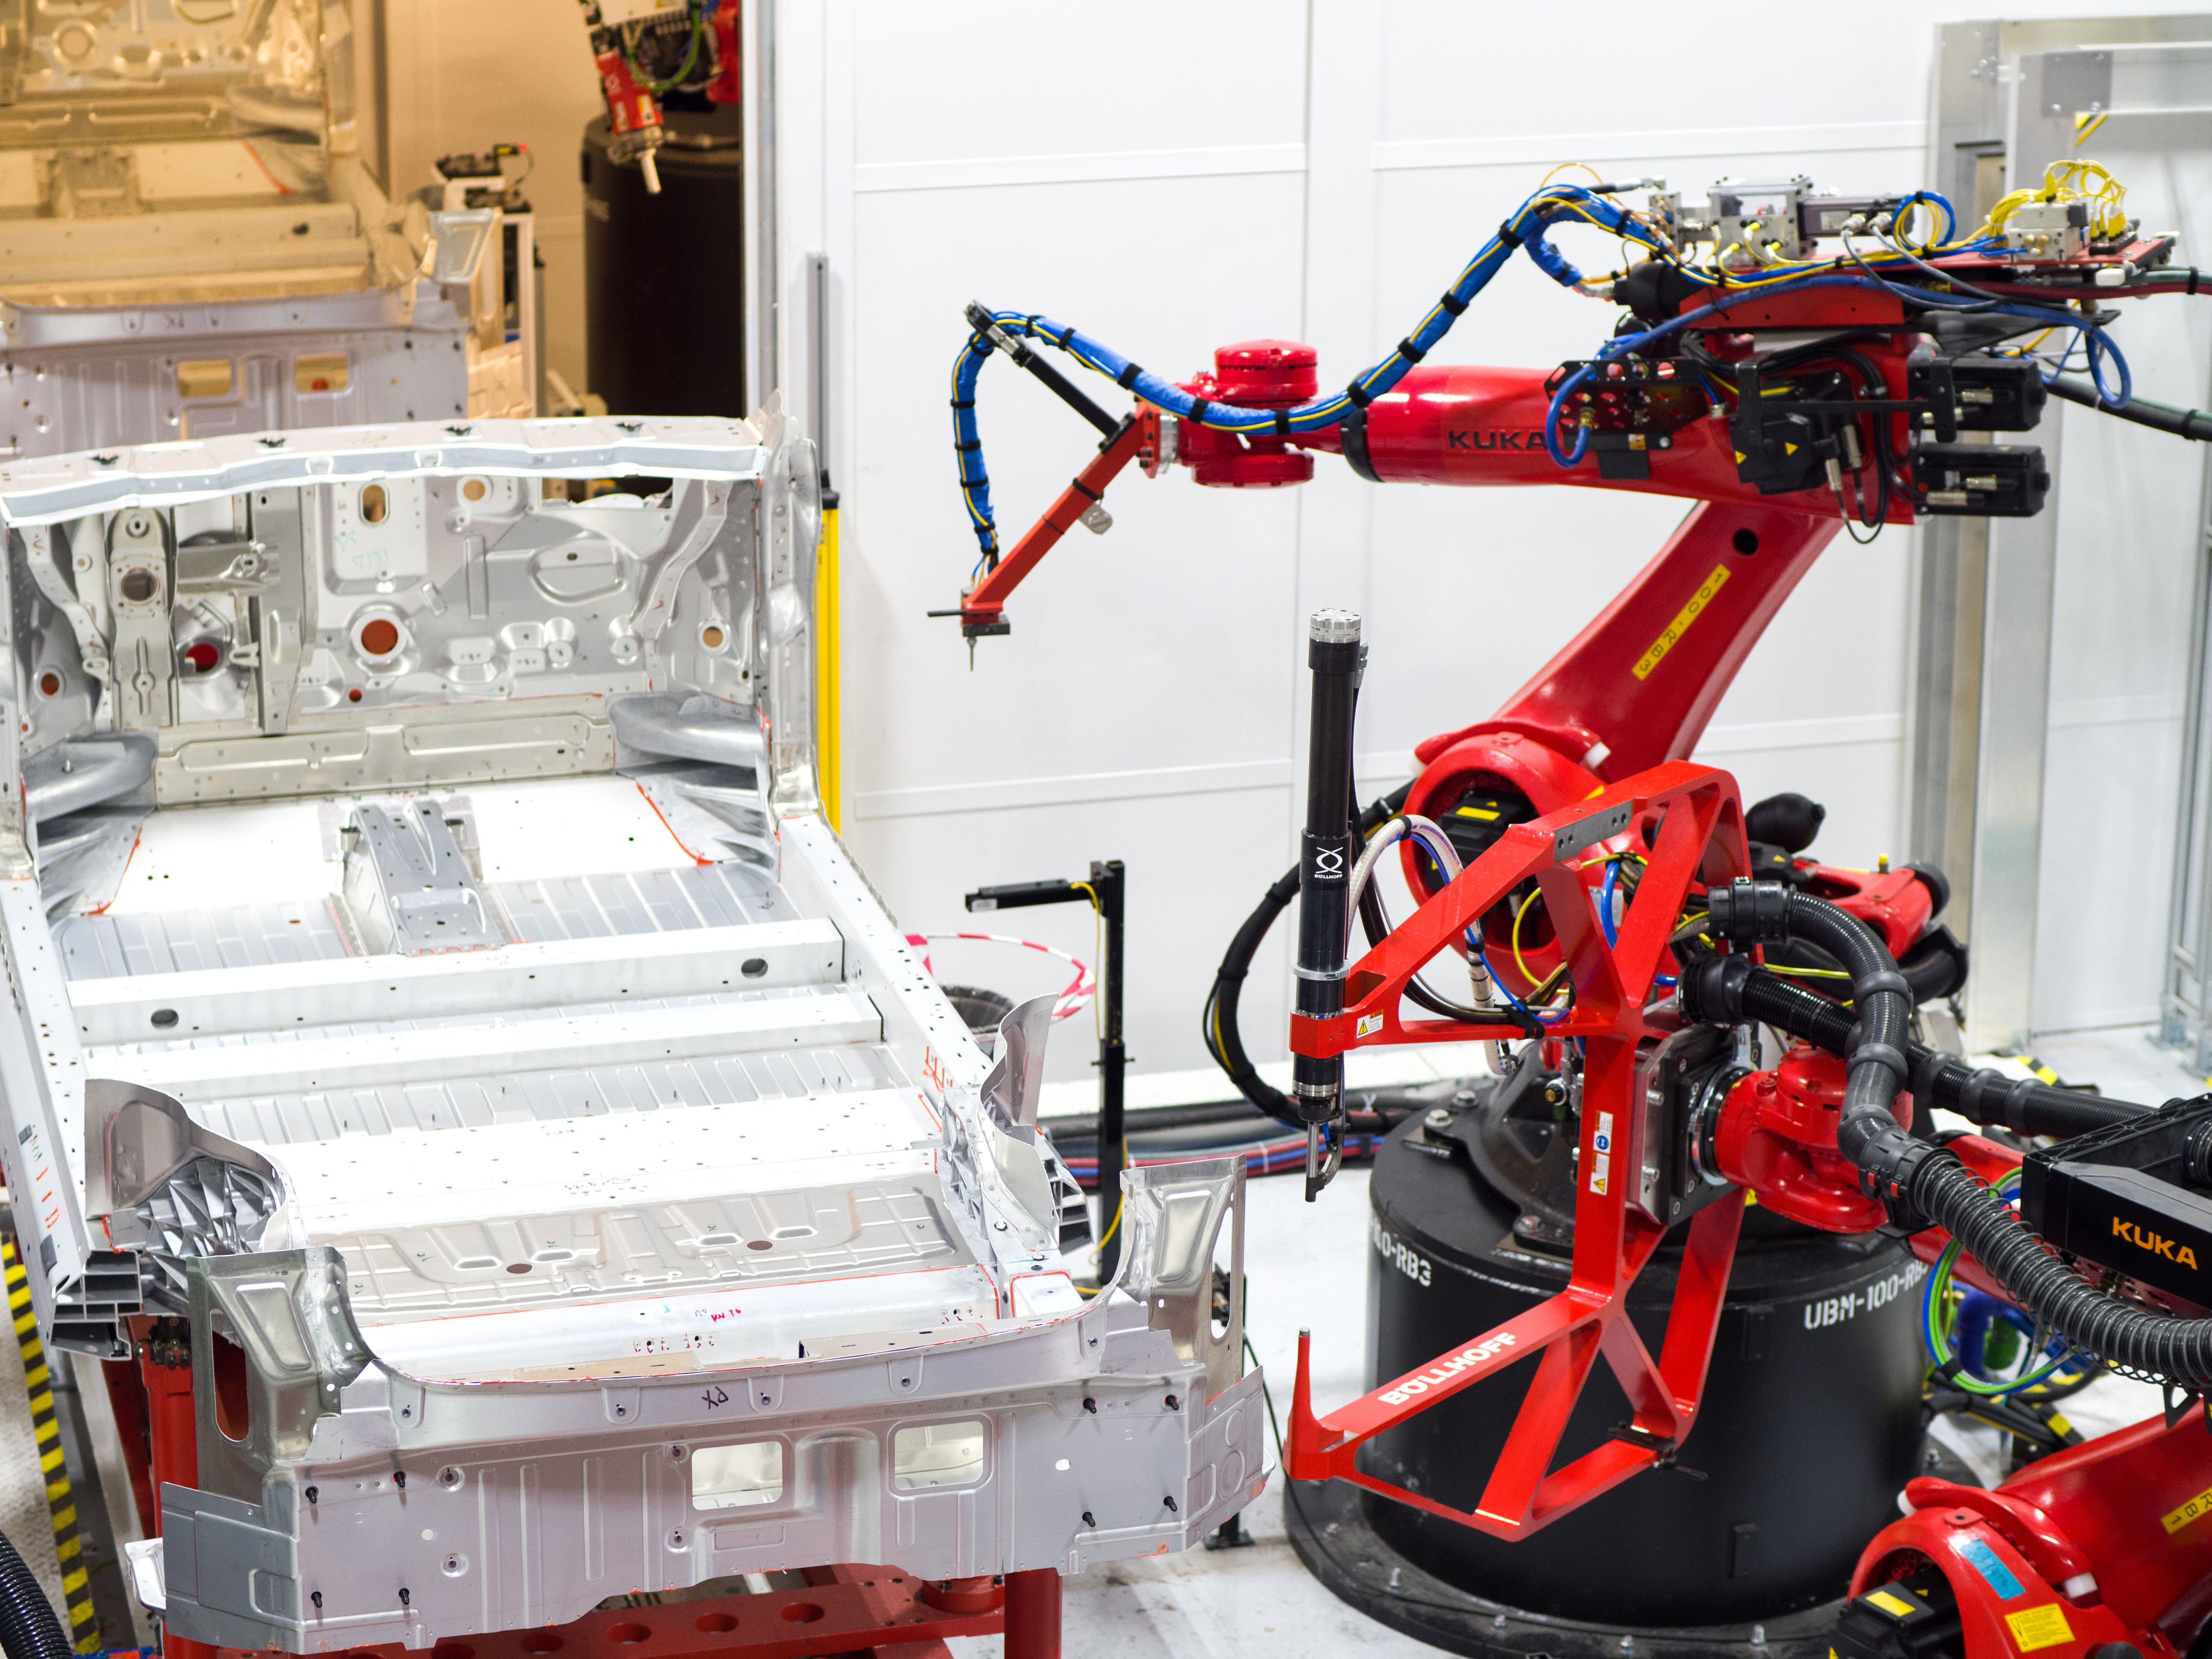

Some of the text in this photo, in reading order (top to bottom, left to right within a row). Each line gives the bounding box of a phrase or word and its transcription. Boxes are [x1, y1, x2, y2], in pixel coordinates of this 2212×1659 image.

[1449, 430, 1548, 449] KUKA
[2113, 1216, 2198, 1270] KUKA
[1377, 1332, 1516, 1405] BÖLLHOFF
